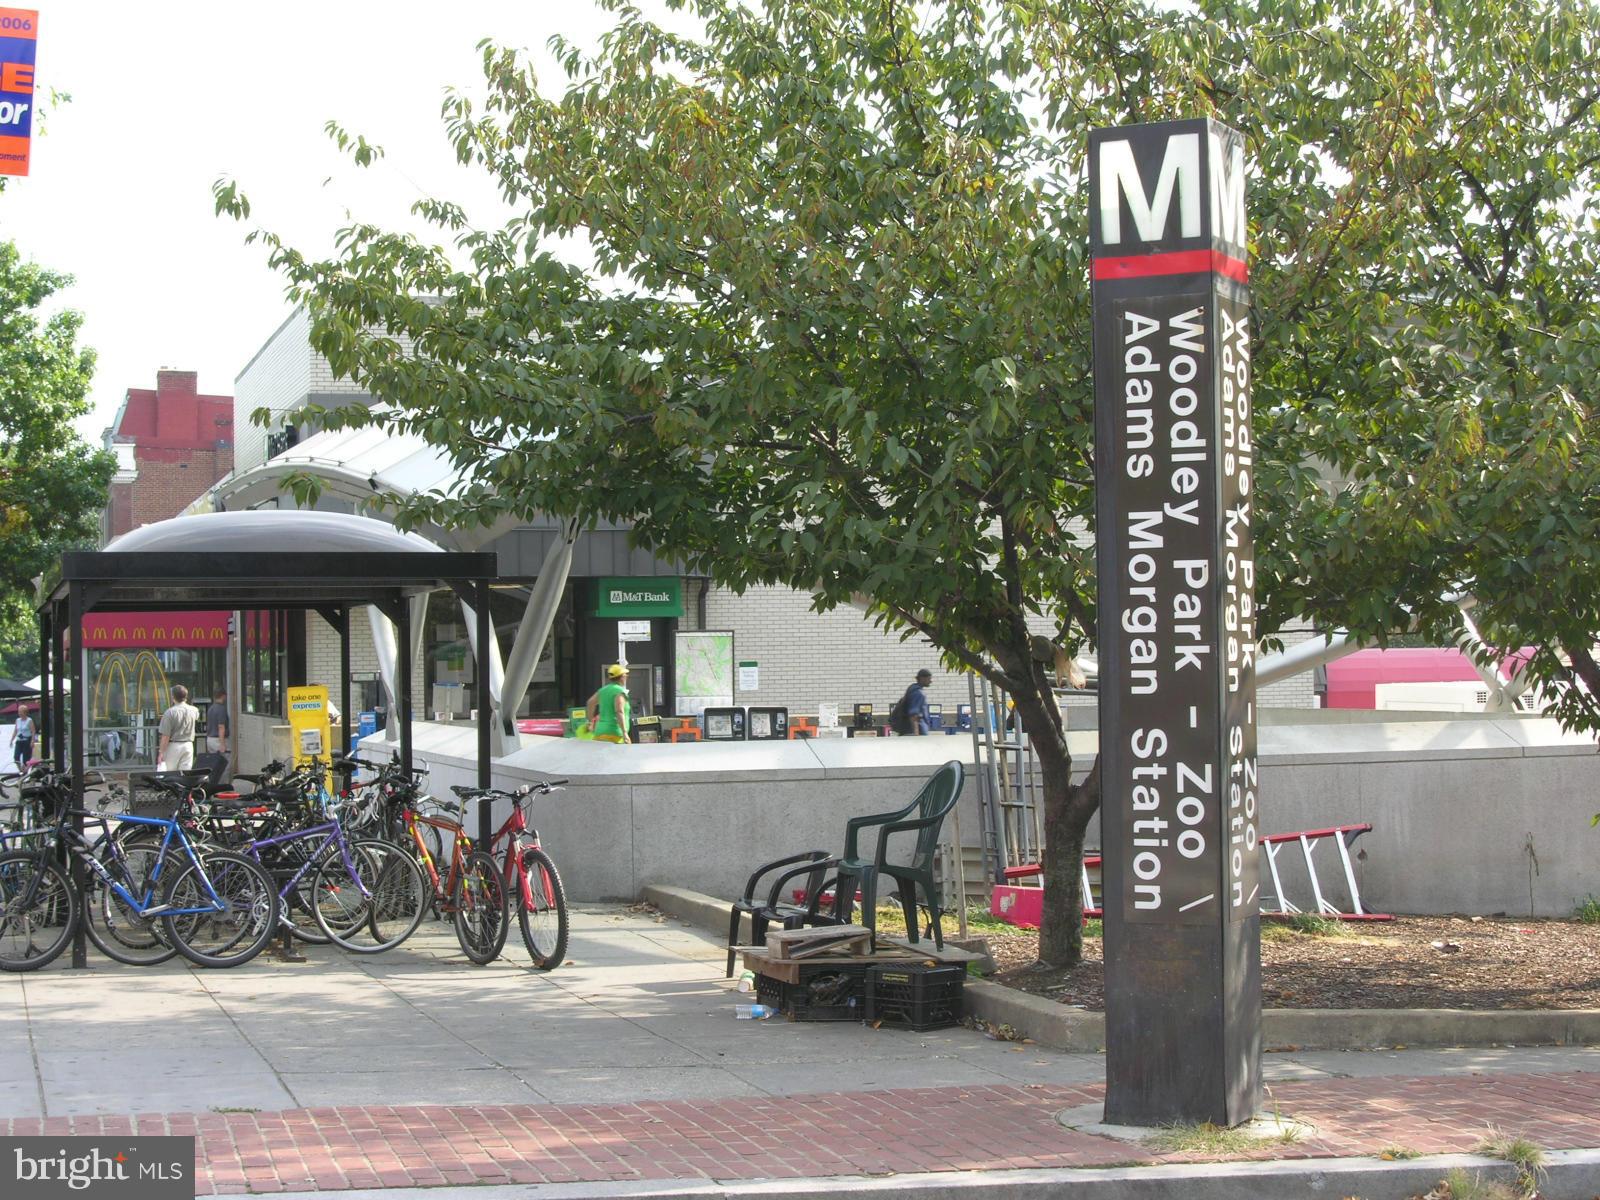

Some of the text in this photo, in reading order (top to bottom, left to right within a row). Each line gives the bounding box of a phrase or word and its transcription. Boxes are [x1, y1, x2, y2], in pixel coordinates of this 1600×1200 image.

[0, 17, 32, 31] 006
[1099, 132, 1202, 245] M
[1209, 132, 1246, 249] M
[1163, 305, 1207, 526] Woodley
[1235, 316, 1252, 527] Woodley
[623, 592, 670, 602] M&T Bank
[1121, 311, 1169, 911] Adams Morgan Station
[1173, 559, 1211, 672] Park
[1221, 307, 1244, 908] Adams Morgan Station
[1240, 559, 1255, 669] Park
[291, 694, 307, 702] take
[293, 703, 321, 711] express
[1176, 761, 1213, 859] Zoo
[1244, 757, 1258, 852] Zoo
